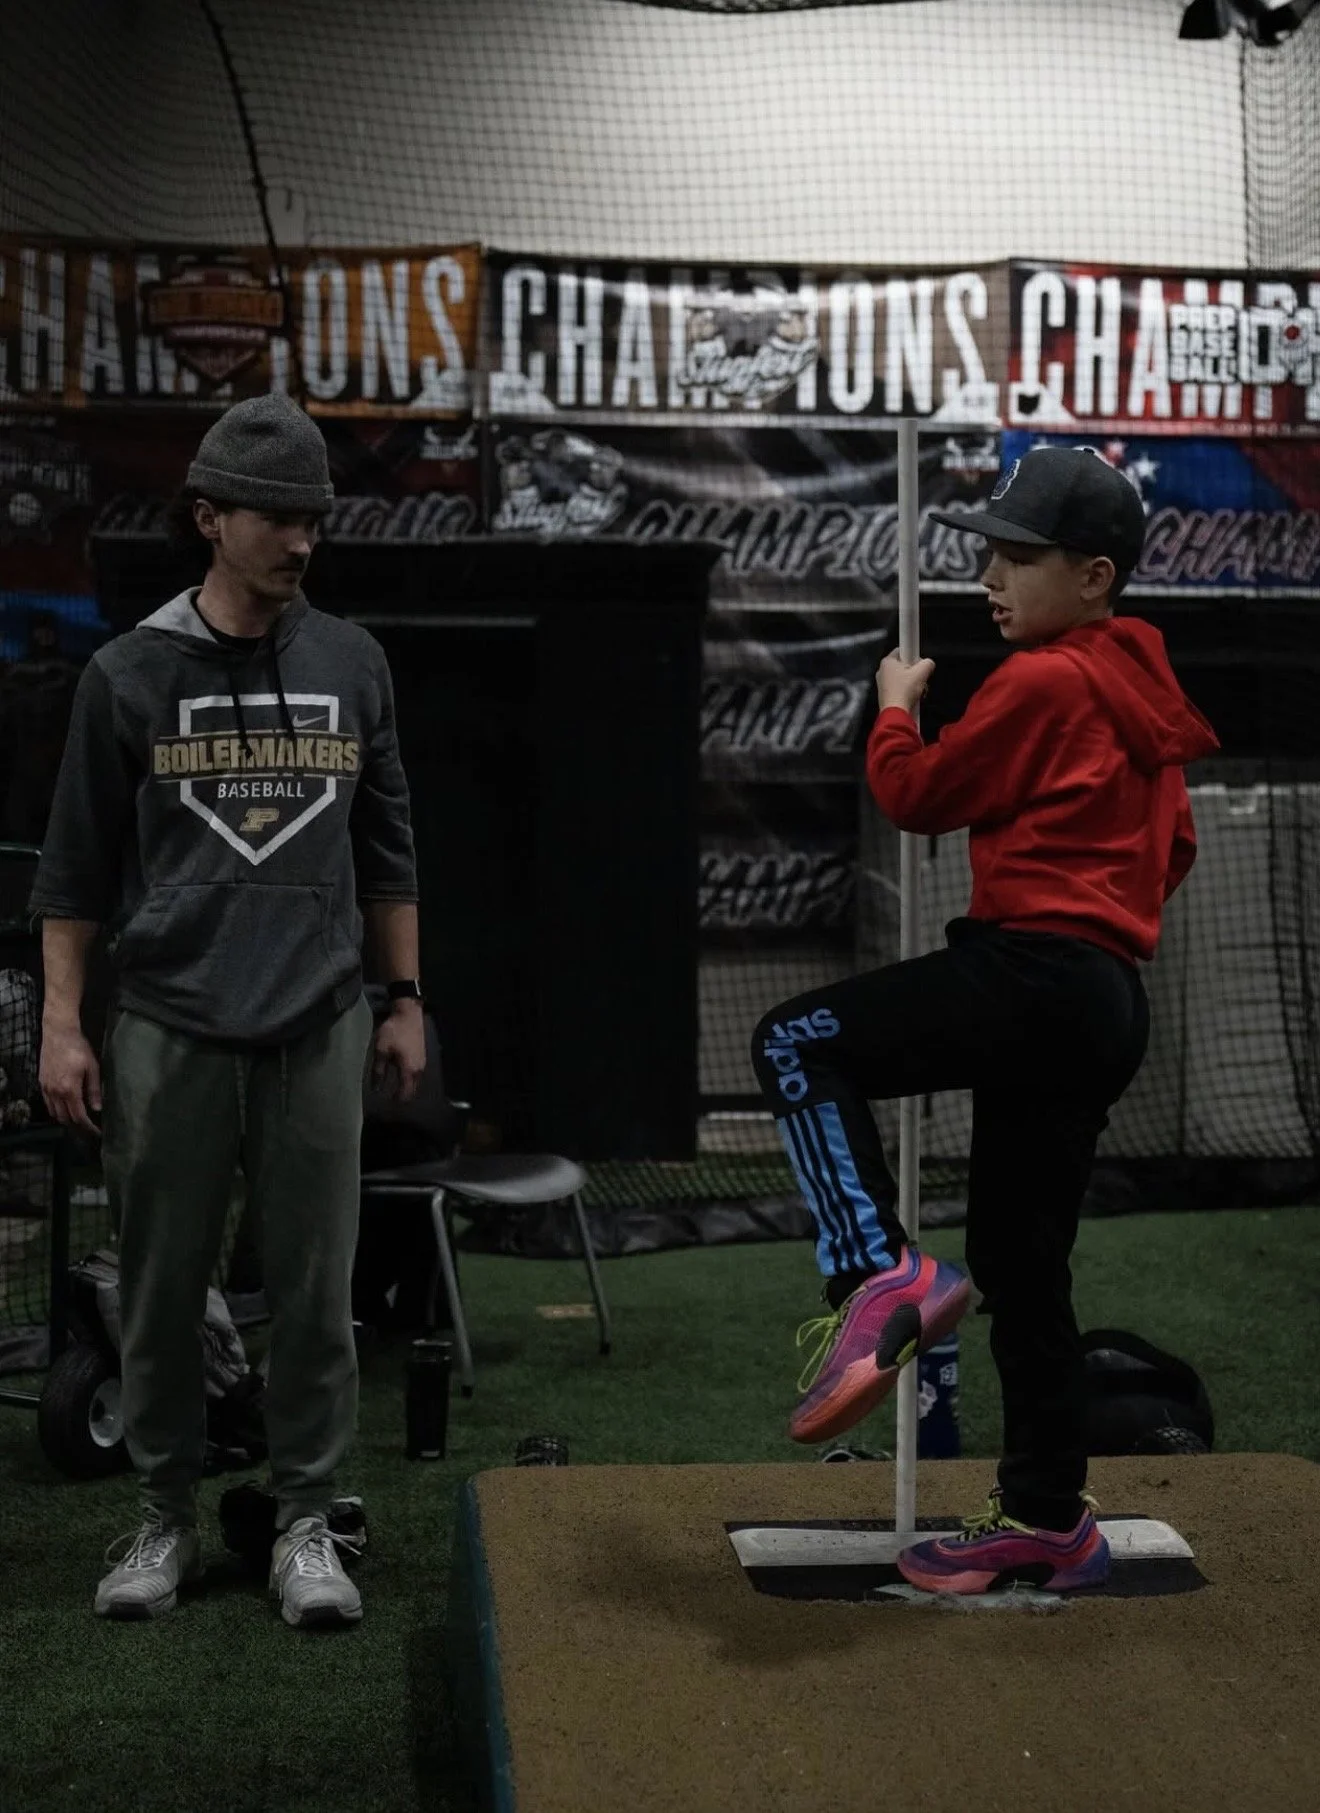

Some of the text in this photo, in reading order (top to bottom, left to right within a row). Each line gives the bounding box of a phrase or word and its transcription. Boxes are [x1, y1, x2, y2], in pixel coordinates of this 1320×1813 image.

[0, 248, 466, 402] HAIONS
[1171, 330, 1234, 356] BASE
[153, 737, 359, 775] BOILERMAKERS
[217, 782, 305, 799] BASEBALL
[239, 807, 281, 832] P
[763, 1006, 841, 1102] adidas
